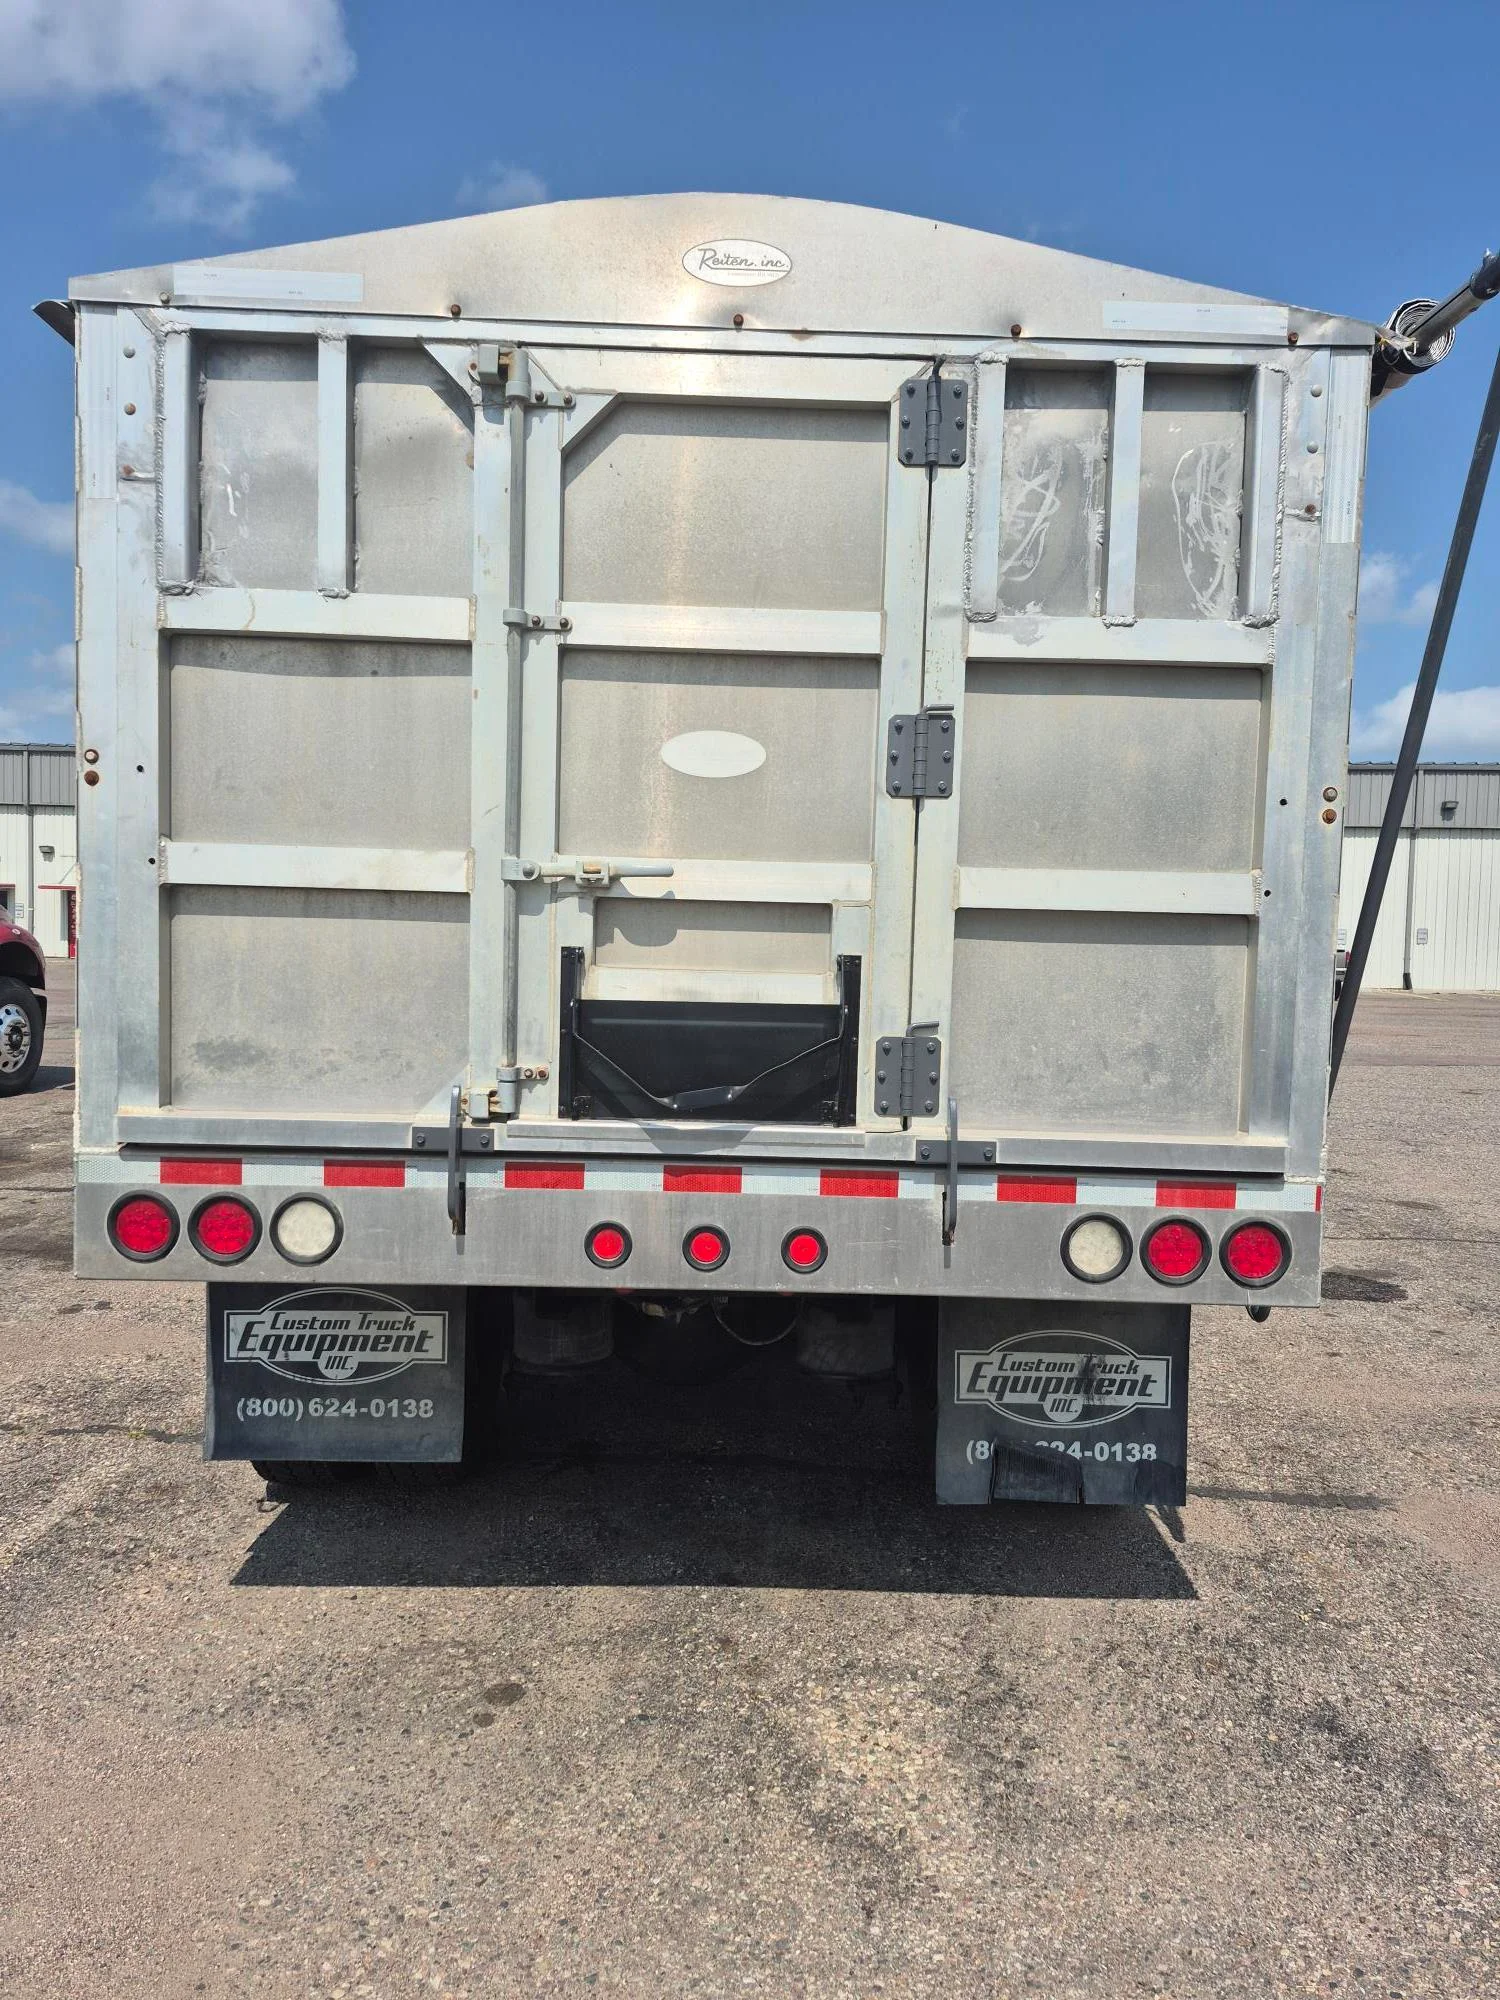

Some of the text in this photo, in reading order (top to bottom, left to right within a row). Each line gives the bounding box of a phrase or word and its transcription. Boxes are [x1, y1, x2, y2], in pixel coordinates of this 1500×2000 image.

[270, 1312, 416, 1331] Custom Truck
[237, 1321, 433, 1360] Equipment
[324, 1355, 354, 1370] INC.
[997, 1353, 1140, 1375] Custom Truck
[966, 1361, 1157, 1401] Equipment
[237, 1397, 434, 1421] (800) 624-0138
[1049, 1398, 1079, 1413] INC.
[1035, 1440, 1157, 1463] 4-0138
